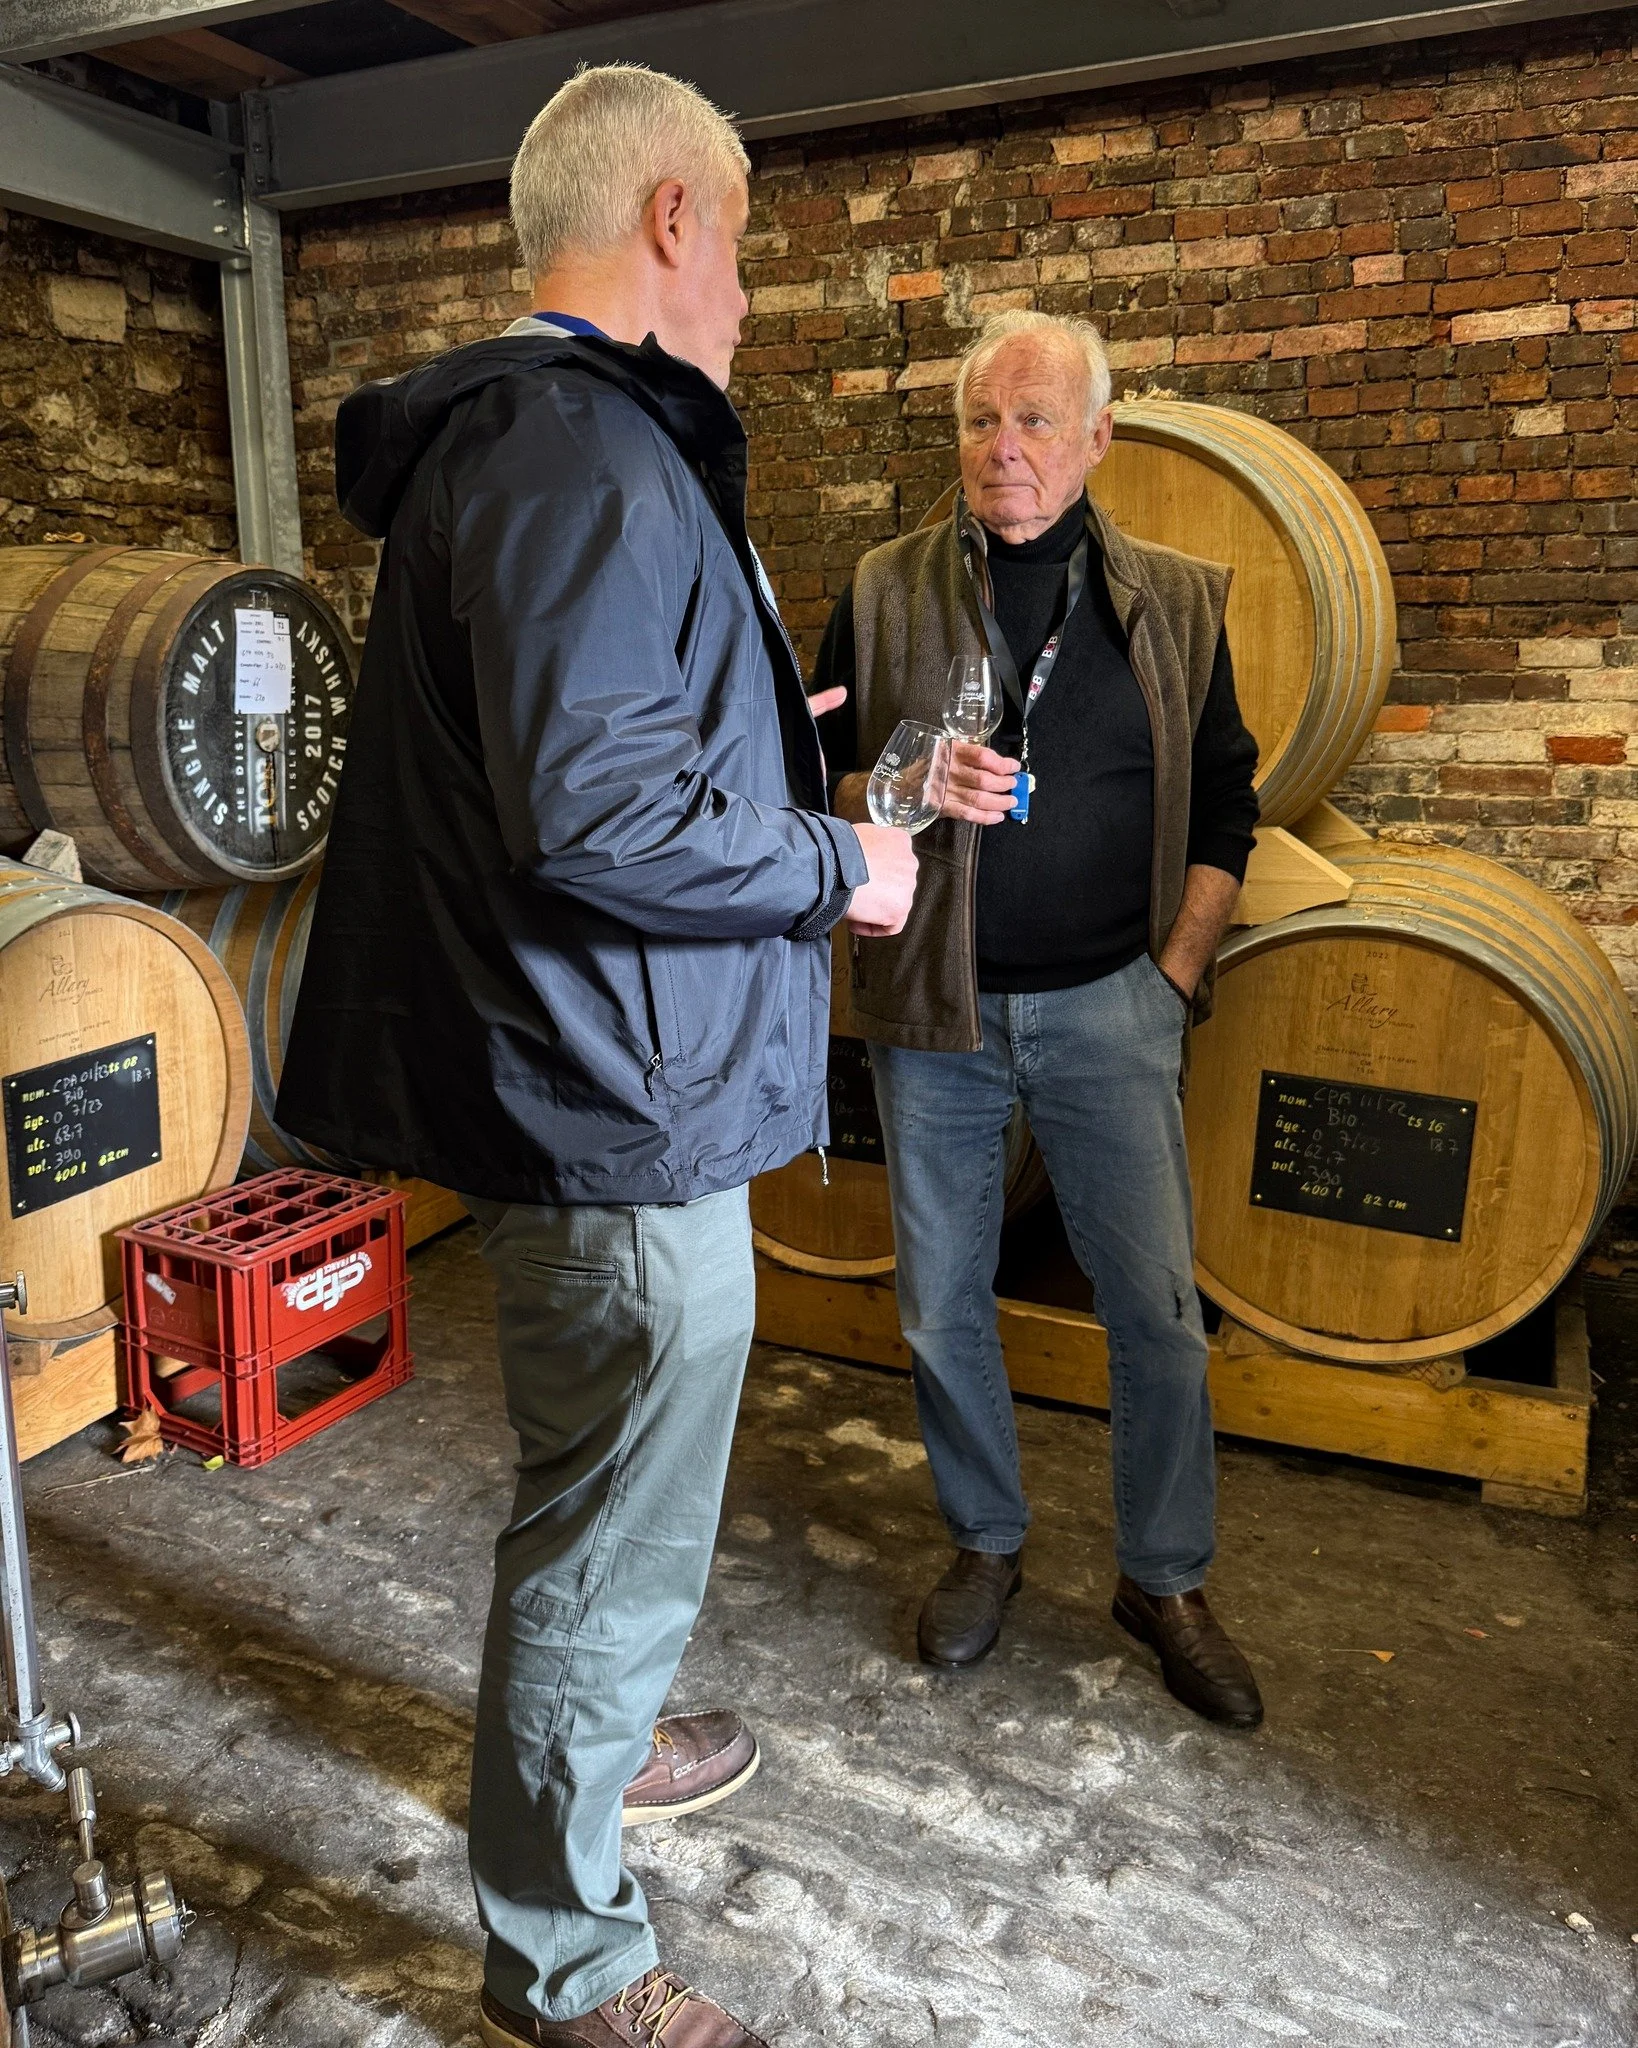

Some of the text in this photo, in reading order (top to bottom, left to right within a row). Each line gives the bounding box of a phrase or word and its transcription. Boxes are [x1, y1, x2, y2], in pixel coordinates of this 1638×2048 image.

[182, 619, 225, 695] MALT
[296, 620, 347, 717] WHISKY
[289, 719, 296, 737] OF
[304, 694, 322, 758] 2017
[178, 717, 228, 826] SINGLE
[296, 736, 347, 831] SCOTCH
[236, 786, 247, 824] THE
[1327, 994, 1398, 1028] Allary
[1427, 1121, 1445, 1133] 16
[54, 1165, 78, 1183] 400
[1300, 1181, 1329, 1197] 400
[1363, 1193, 1382, 1206] 82
[1388, 1198, 1407, 1211] cm
